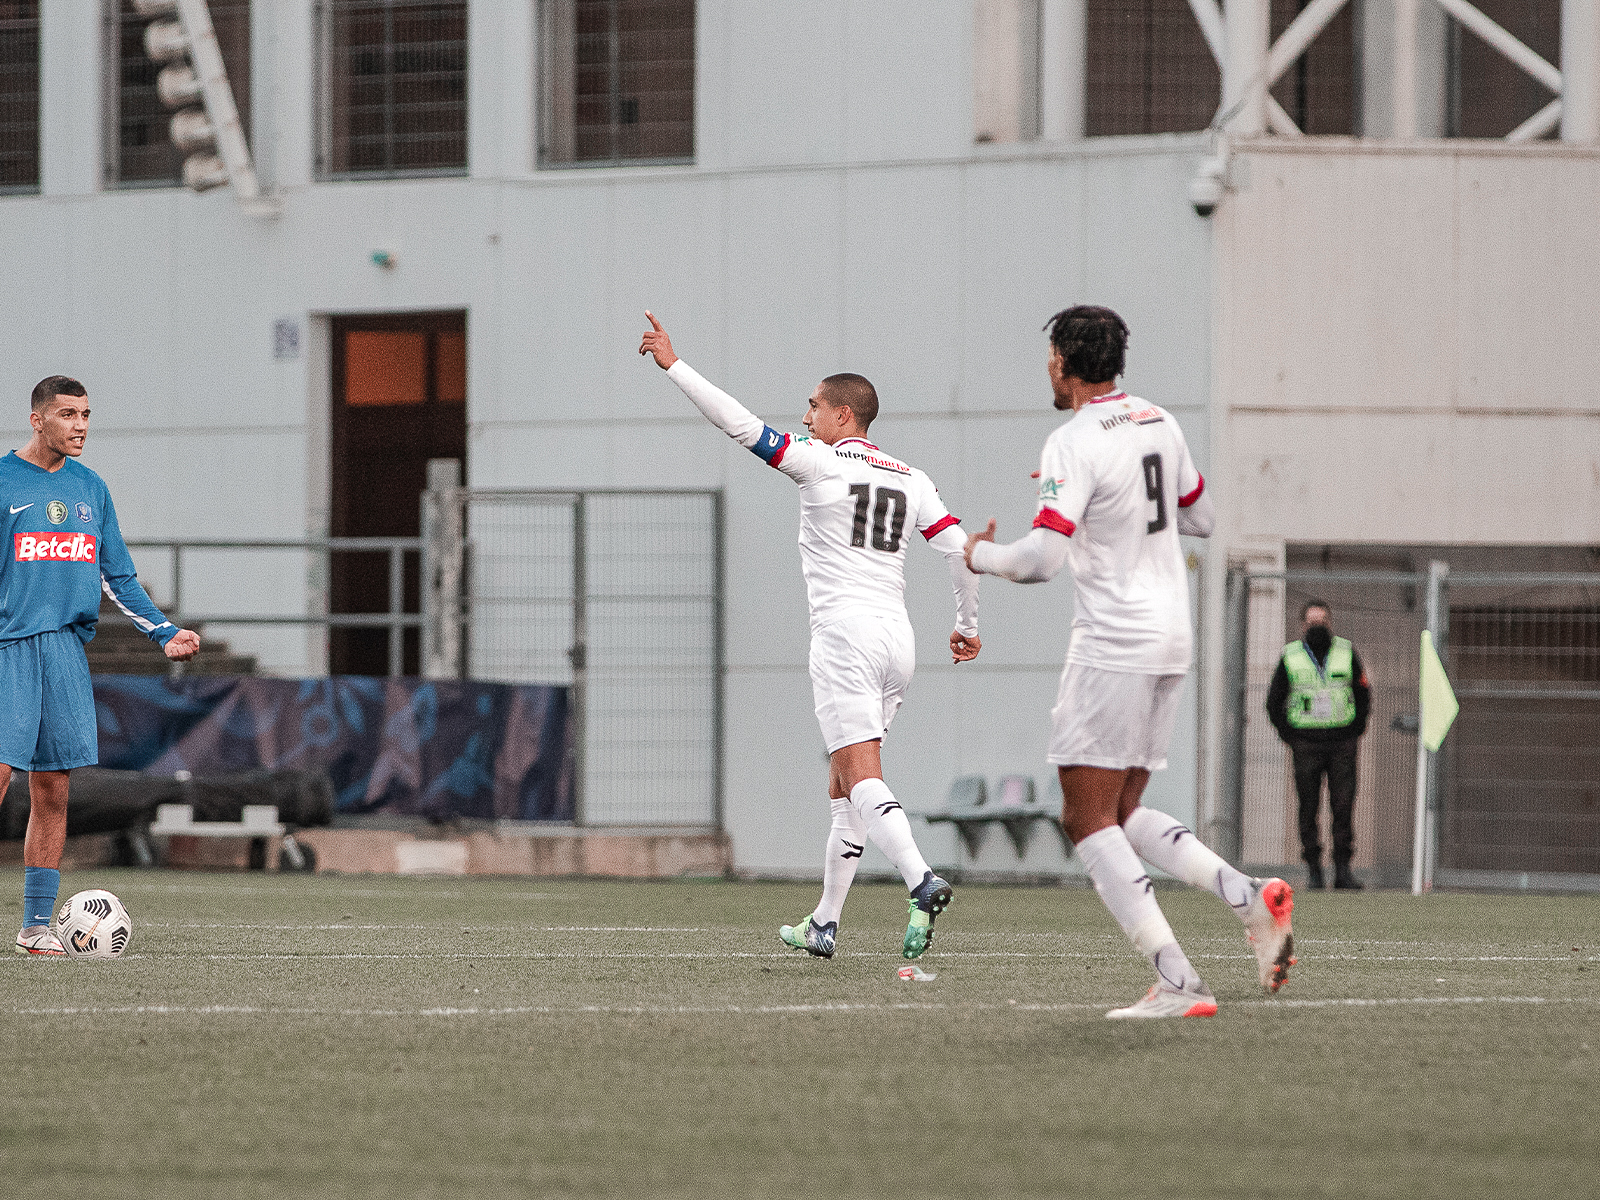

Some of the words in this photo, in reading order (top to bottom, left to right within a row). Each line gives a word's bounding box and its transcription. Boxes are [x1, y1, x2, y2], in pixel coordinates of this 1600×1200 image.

[848, 482, 907, 553] 10
[1142, 452, 1168, 535] 9
[19, 535, 95, 560] Betclic
